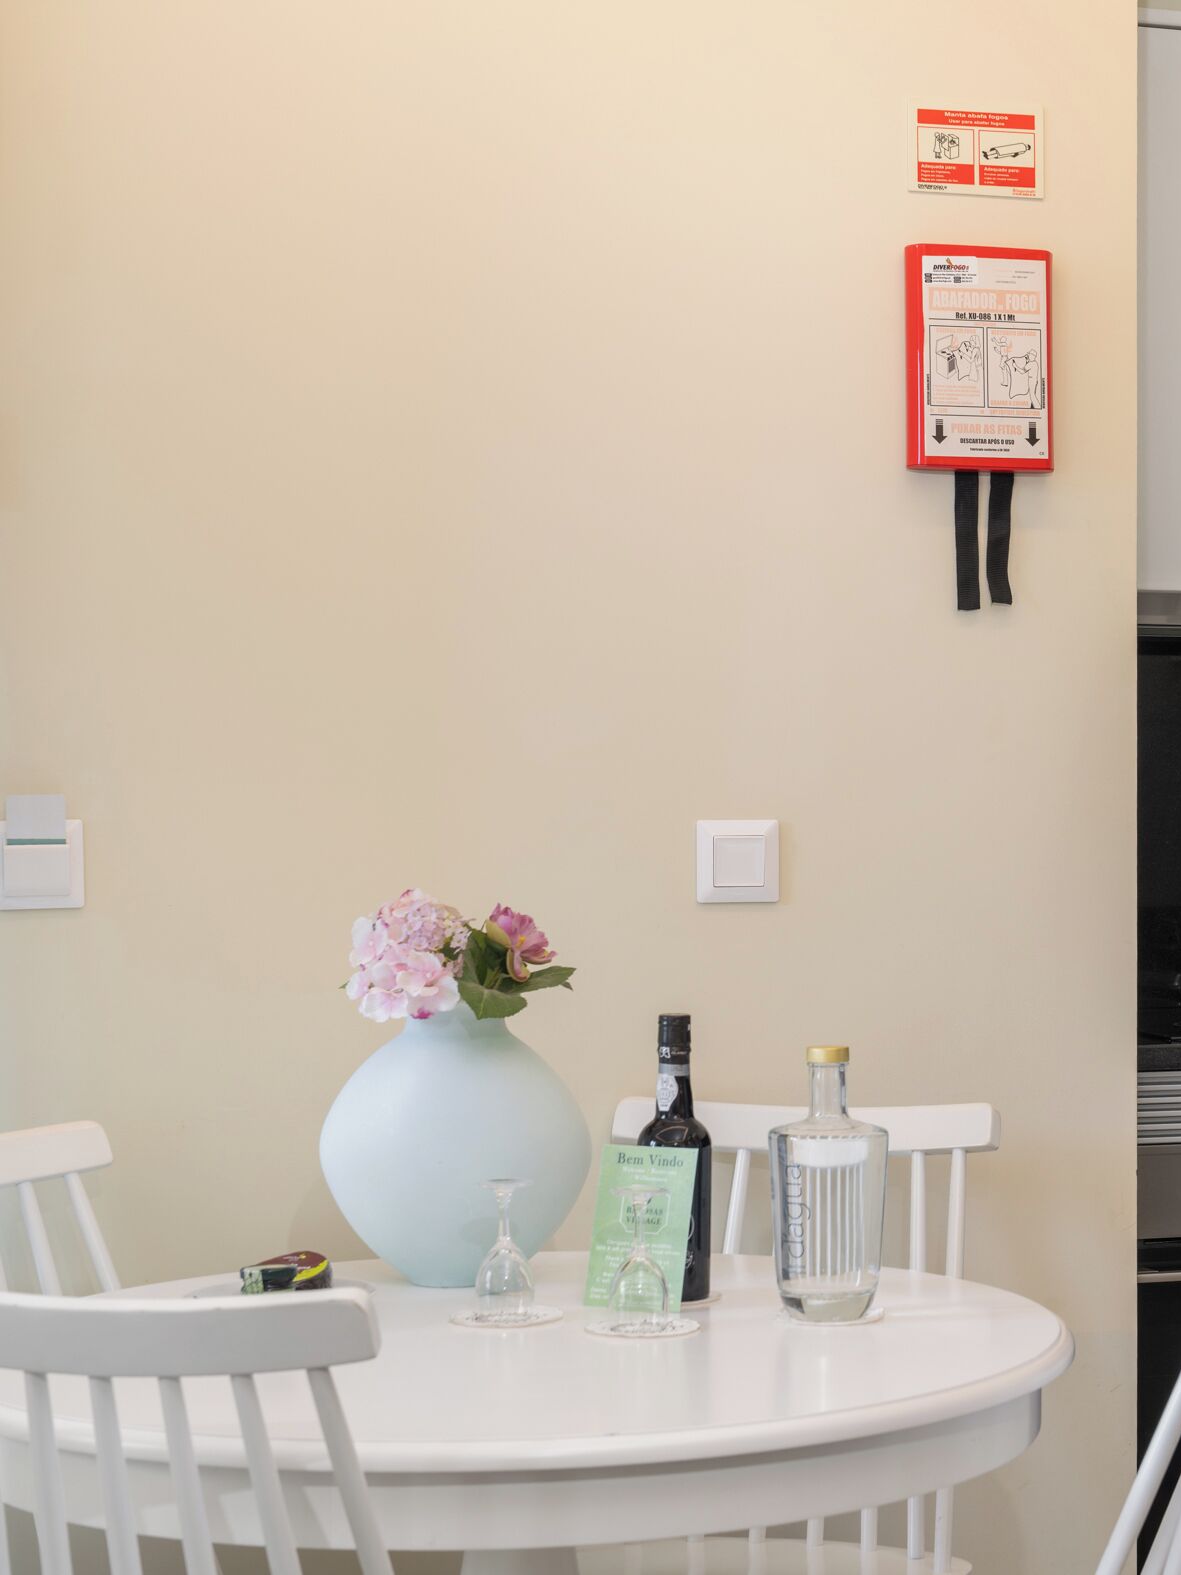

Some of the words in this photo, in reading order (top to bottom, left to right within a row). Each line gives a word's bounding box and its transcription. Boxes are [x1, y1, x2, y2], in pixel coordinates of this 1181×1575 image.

[932, 290, 997, 310] ABAFADOR
[1005, 293, 1037, 311] FOGO
[951, 423, 982, 434] PUXAR
[983, 424, 996, 434] AS
[997, 424, 1022, 435] FITAS
[617, 1152, 644, 1165] Bem
[649, 1154, 684, 1167] Vindo
